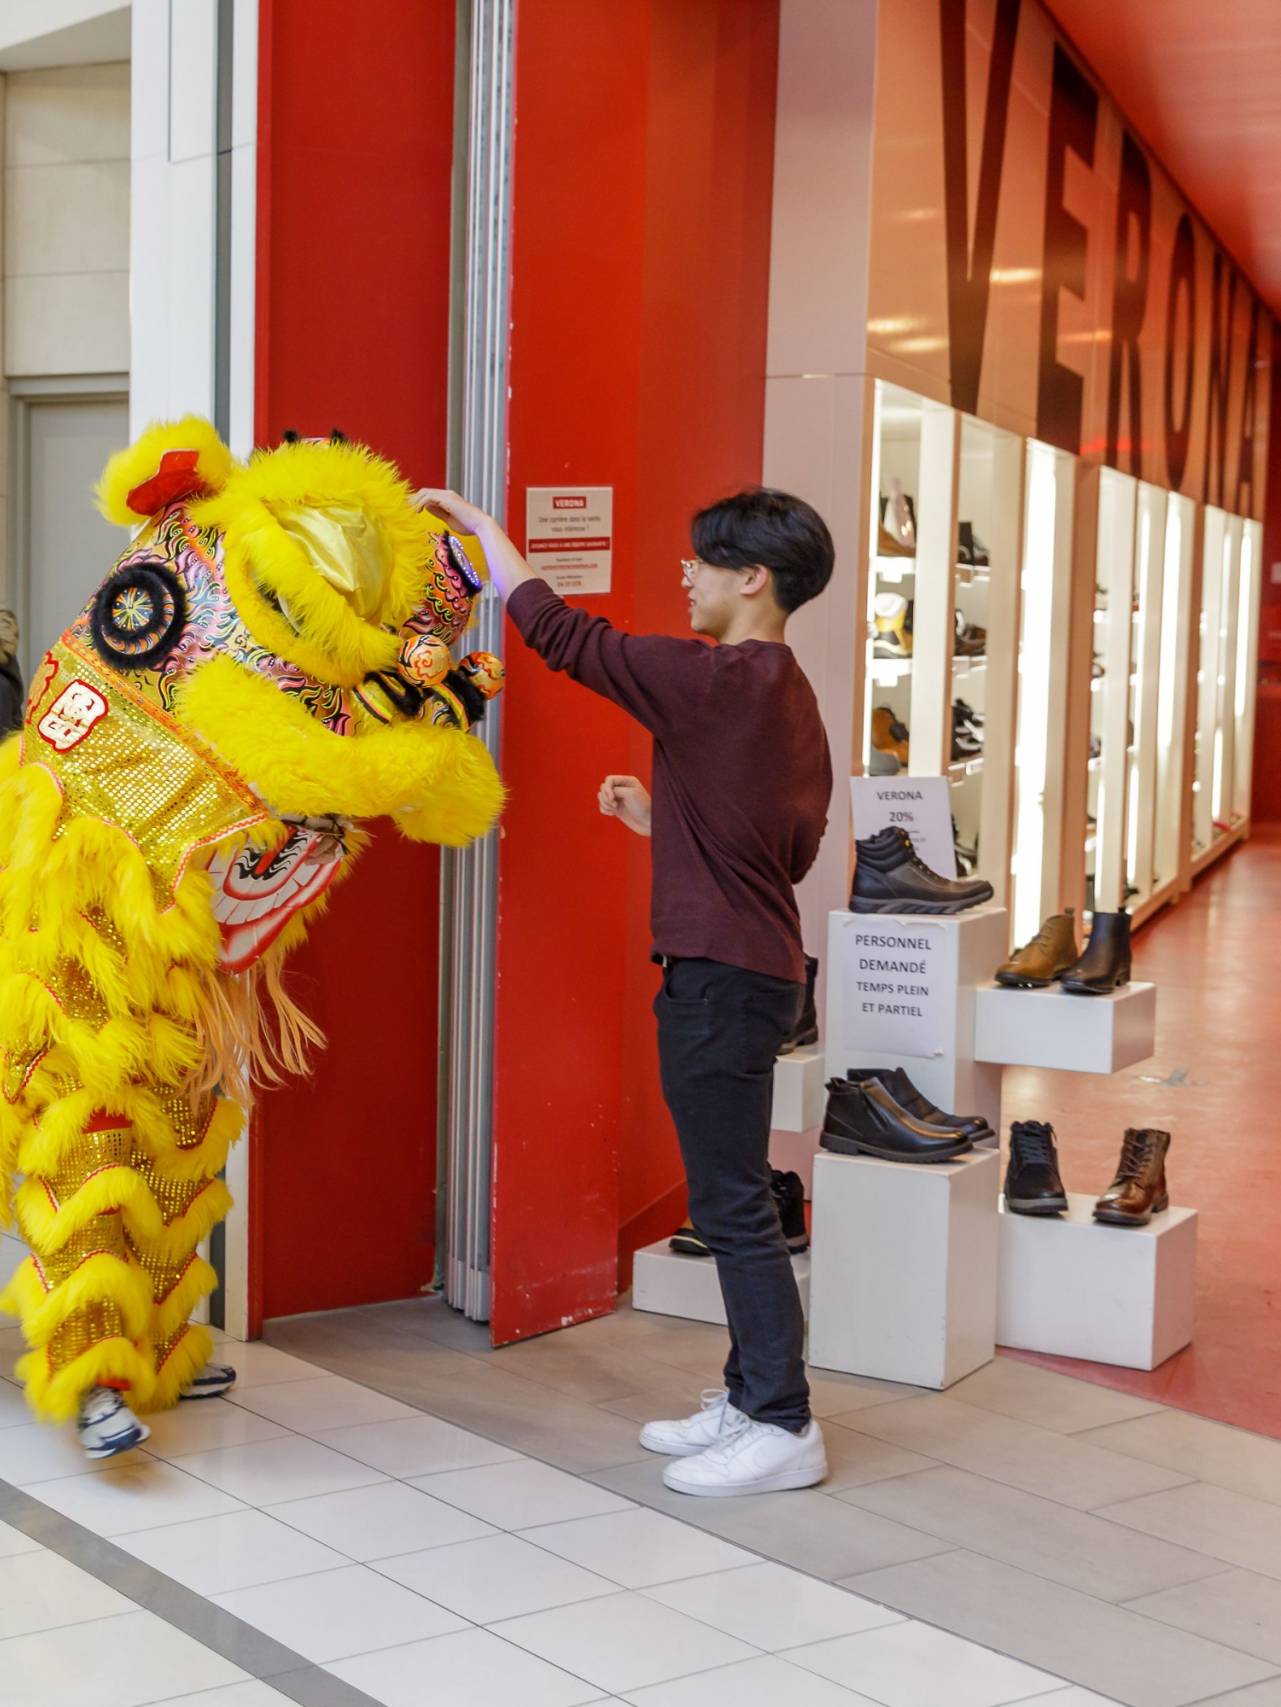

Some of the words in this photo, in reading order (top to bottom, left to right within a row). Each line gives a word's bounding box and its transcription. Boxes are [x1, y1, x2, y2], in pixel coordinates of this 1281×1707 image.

[939, 0, 1260, 514] VERONA
[555, 499, 585, 508] VERONA
[876, 791, 924, 801] VERONA
[889, 811, 914, 822] 20%
[855, 934, 932, 950] PERSONNEL
[859, 958, 927, 974] DEMANDÉ
[856, 981, 894, 994] TEMPS
[897, 984, 929, 996] PLEIN
[862, 1002, 875, 1013] ET
[878, 1003, 923, 1017] PARTIEL
